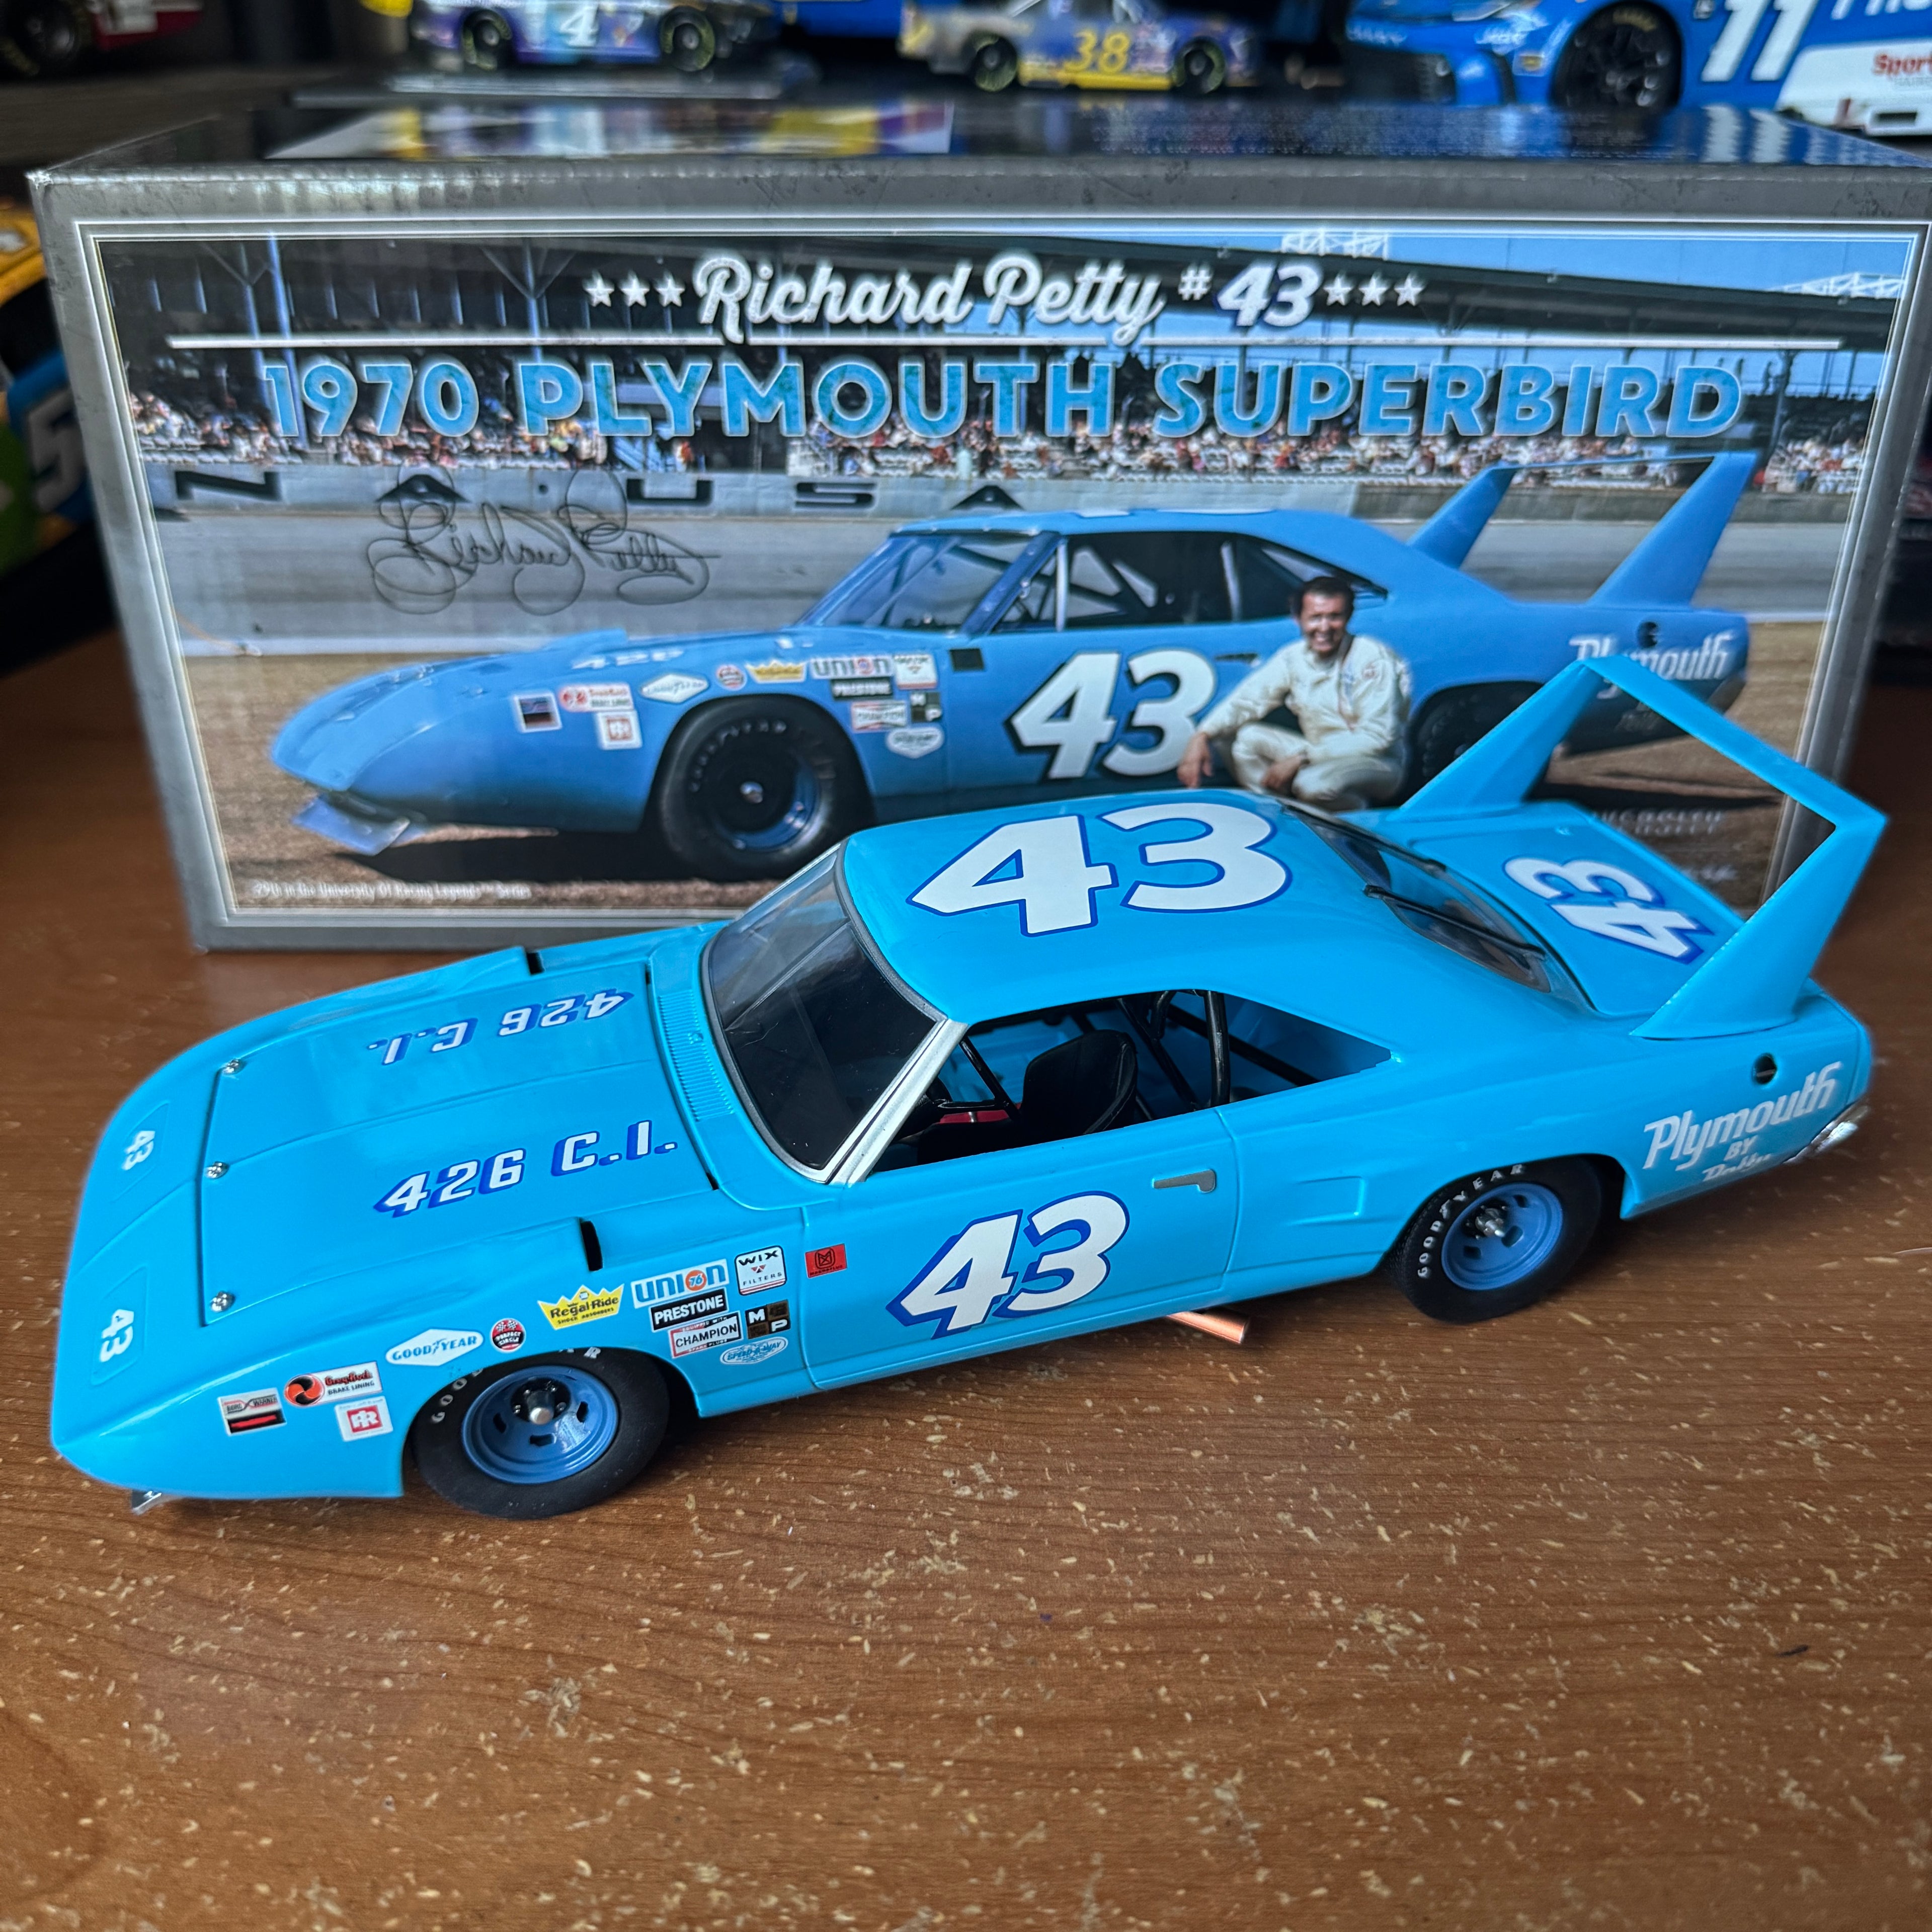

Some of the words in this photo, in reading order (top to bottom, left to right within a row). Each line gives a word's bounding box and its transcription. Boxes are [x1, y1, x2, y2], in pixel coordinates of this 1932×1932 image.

[1064, 29, 1133, 73] 38
[692, 254, 974, 344] Richard
[982, 249, 1166, 346] Petty
[262, 359, 479, 438] 1970
[518, 360, 1114, 438] PLYMOUTH
[1151, 360, 1743, 438] SUPERBIRD
[1005, 649, 1216, 781] 43
[906, 801, 1293, 938] 43
[1502, 857, 1712, 964] 43
[498, 988, 634, 1037] 426
[1643, 1060, 1842, 1171] Plymouth
[121, 1131, 155, 1171] 43
[374, 1148, 526, 1218] 426
[551, 1119, 678, 1176] C.I.
[1723, 1134, 1759, 1162] BY
[1417, 1163, 1525, 1279] GOODYEAR
[738, 1250, 779, 1266] WIX
[743, 1271, 783, 1286] FILTERS
[886, 1190, 1130, 1340] 43
[689, 1273, 704, 1287] 76
[557, 1316, 579, 1325] SHOCK
[654, 1294, 725, 1325] PRESTONE
[100, 1309, 134, 1363] 43
[392, 1335, 477, 1361] GOODYEAR
[495, 1331, 521, 1341] PERFECT
[498, 1337, 520, 1346] CIRCLE
[675, 1323, 737, 1348] CHAMPION
[328, 1386, 351, 1396] BRAKE
[352, 1380, 375, 1391] LINING
